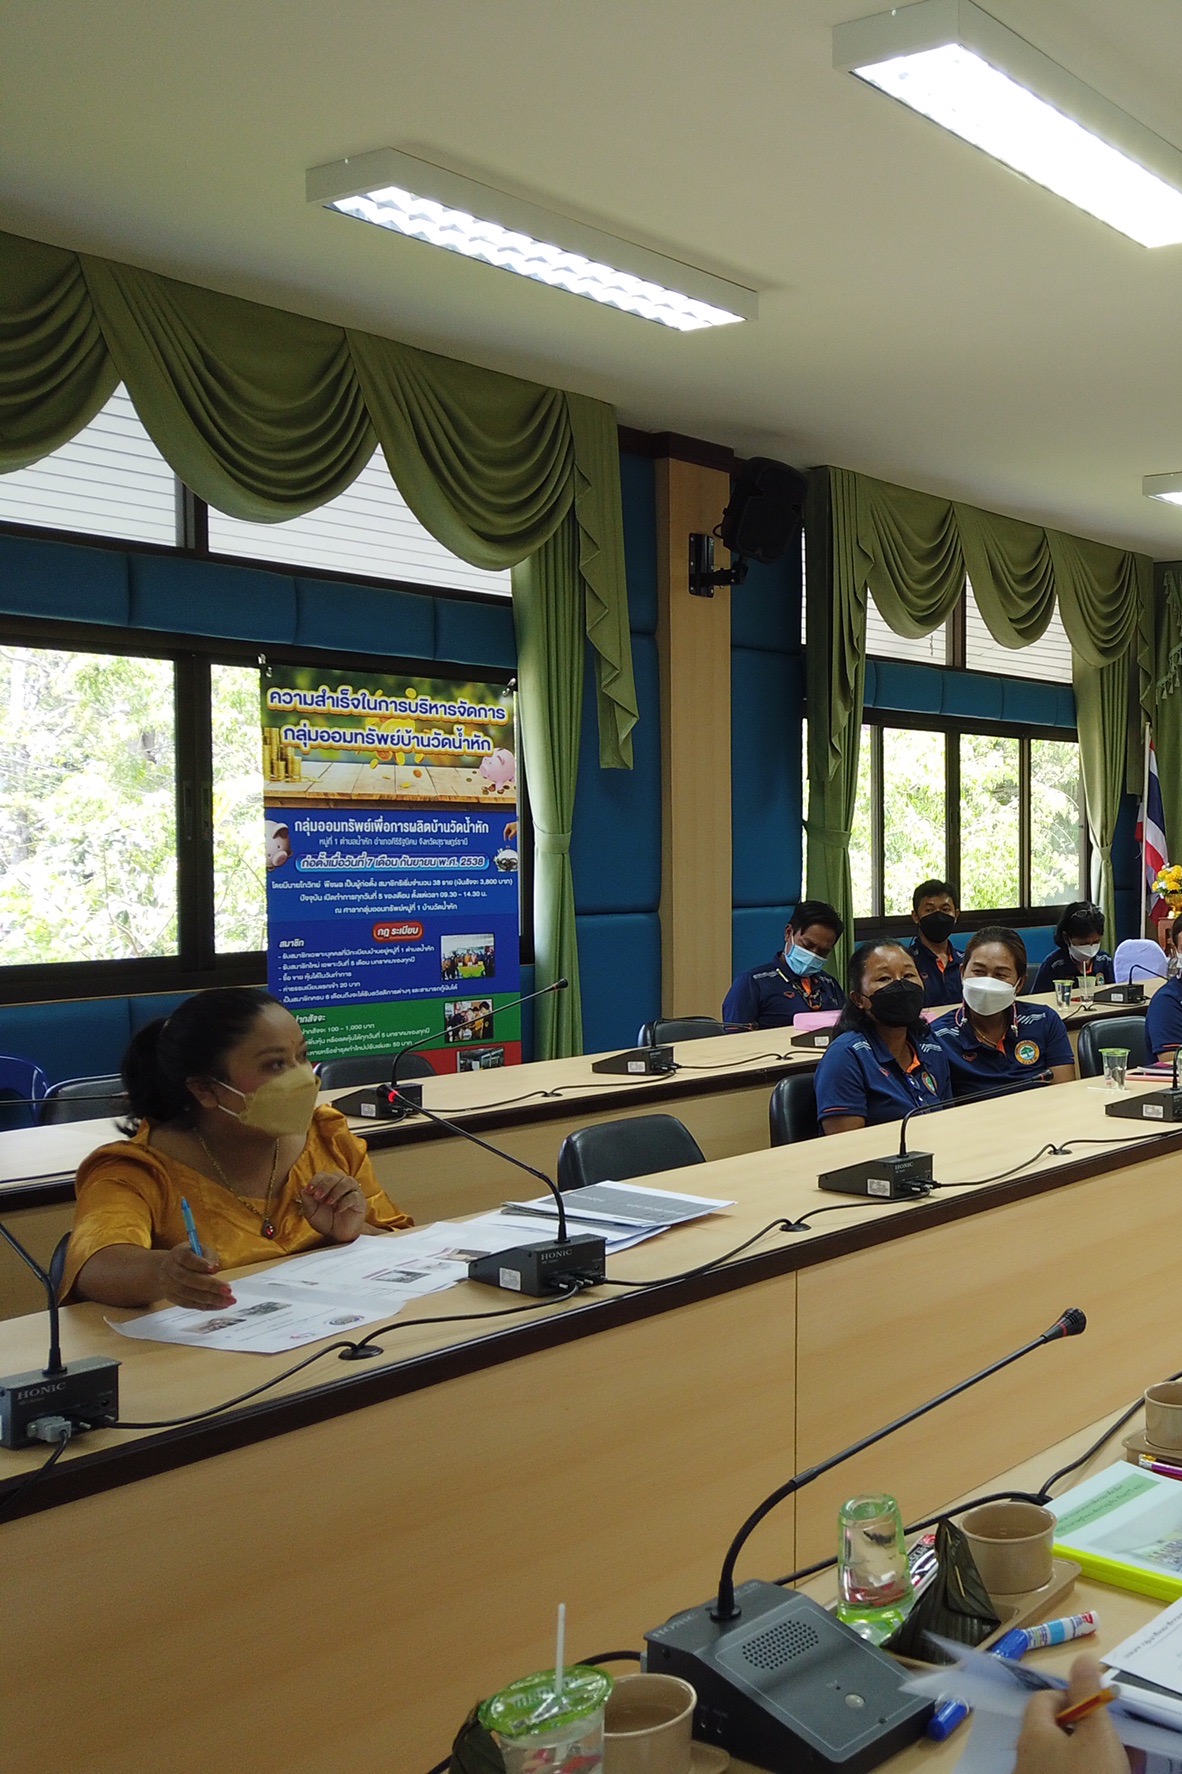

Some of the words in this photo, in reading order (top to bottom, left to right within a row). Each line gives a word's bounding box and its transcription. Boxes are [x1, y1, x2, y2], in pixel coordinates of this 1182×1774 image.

[269, 685, 506, 720] ความสำเร็จในการบริหารจัดการ
[283, 723, 492, 752] กลุ่มออมทรัพย์บ้านวัดน้ำหัก
[294, 816, 489, 836] กลุ่มออมทรัพย์เพื่อการผลิตบ้านวัดน้ำหัก
[301, 852, 366, 868] ก่อตั้งเมื่อวันที่
[367, 858, 375, 867] 7
[376, 855, 397, 867] เดือน
[399, 856, 436, 867] กันยายน
[438, 857, 457, 867] พ.ศ.
[460, 857, 485, 867] 2538
[391, 925, 419, 935] ระเบียบ
[279, 939, 304, 948] สมาชิก
[540, 1248, 572, 1261] HONIC
[17, 1381, 66, 1400] HONIC
